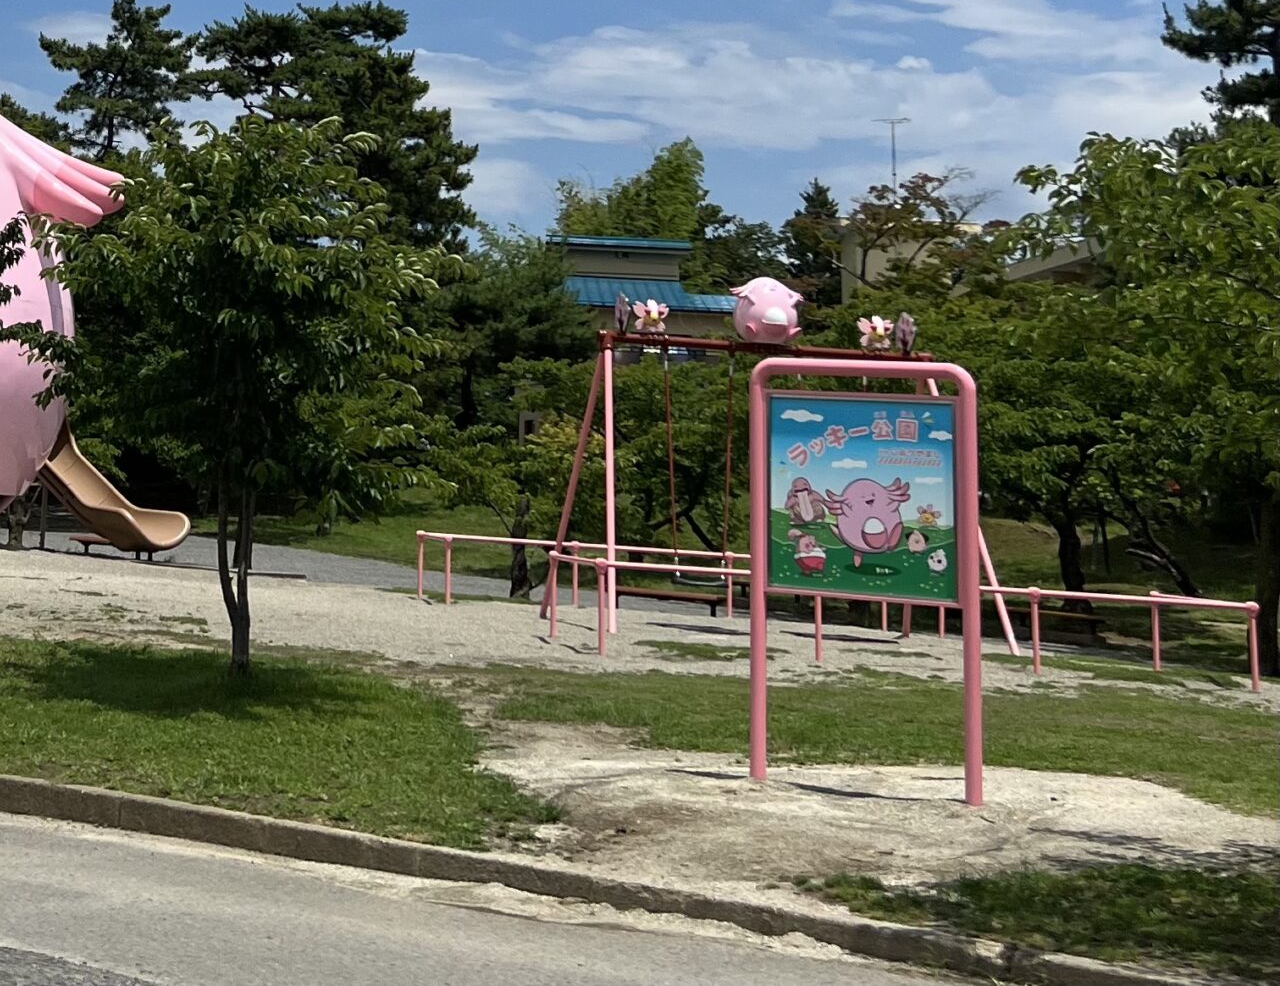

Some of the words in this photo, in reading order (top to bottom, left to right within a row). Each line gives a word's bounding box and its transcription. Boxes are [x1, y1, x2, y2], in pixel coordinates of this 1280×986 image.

[787, 419, 918, 467] ラッキー公園
